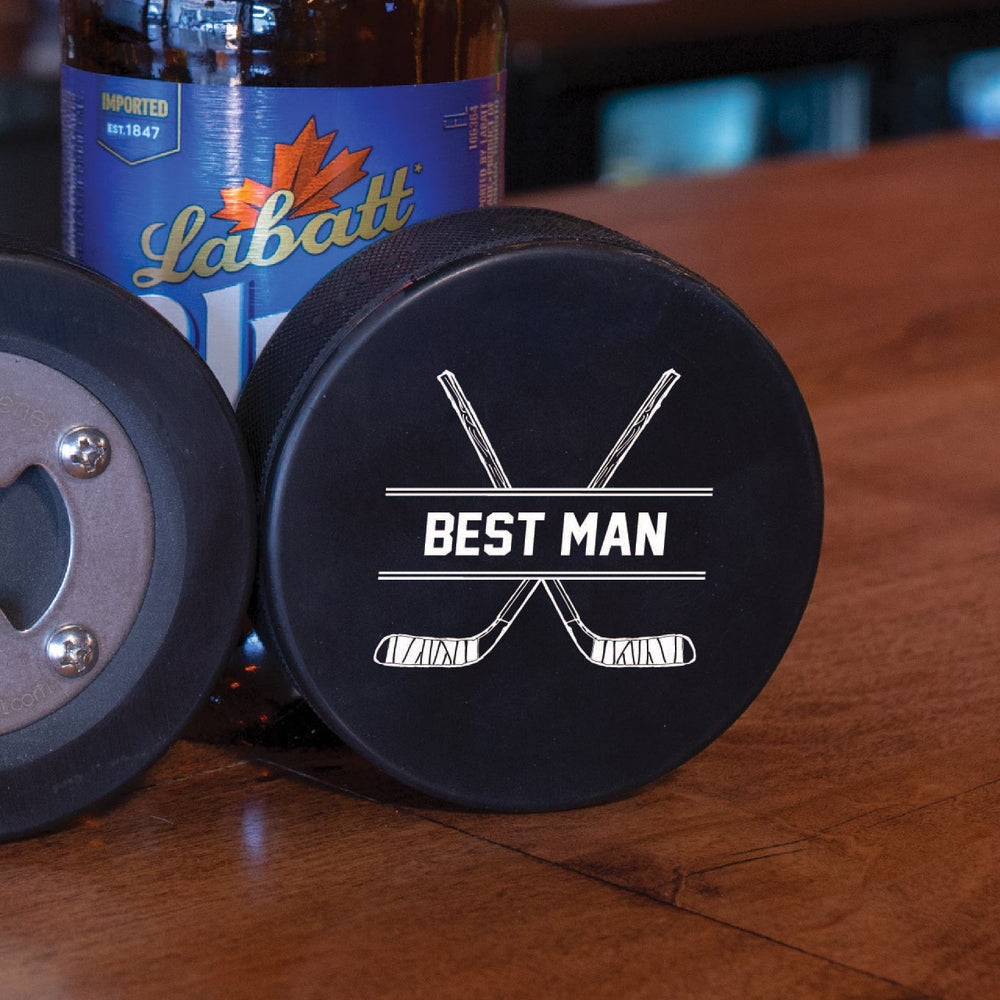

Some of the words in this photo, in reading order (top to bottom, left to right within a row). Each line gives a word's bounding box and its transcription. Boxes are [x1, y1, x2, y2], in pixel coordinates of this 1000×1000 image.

[101, 91, 169, 118] IMPORTED
[132, 163, 416, 289] Labatt
[423, 511, 546, 556] BEST
[560, 511, 668, 556] MAN
